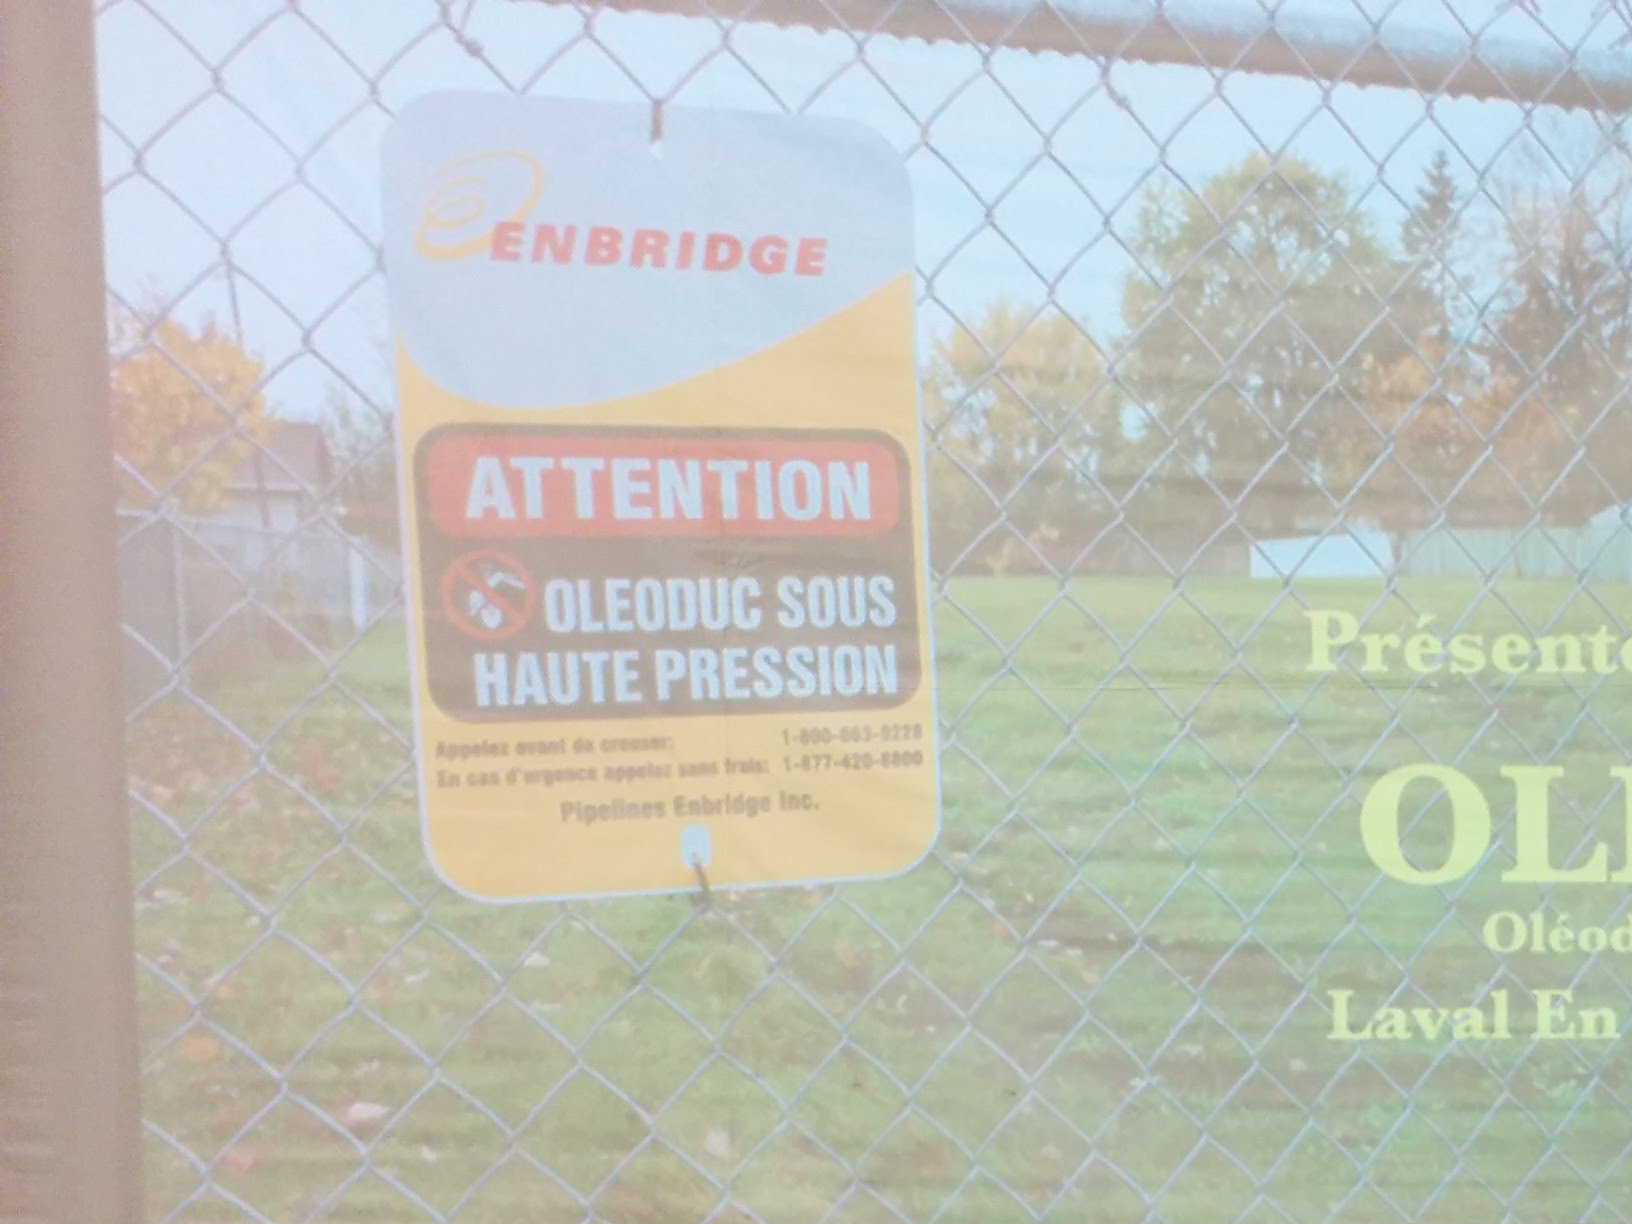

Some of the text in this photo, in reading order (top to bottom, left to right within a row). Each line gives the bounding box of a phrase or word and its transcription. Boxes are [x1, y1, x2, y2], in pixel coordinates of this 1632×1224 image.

[489, 221, 828, 276] ENBRIDGE
[465, 455, 872, 520] ATTENTION
[545, 575, 896, 633] OLEODUC SOUS
[474, 644, 898, 706] HAUTE PRESSION
[561, 789, 820, 825] Pipelines Enbridge Inc.
[1326, 989, 1512, 1041] Laval
[1531, 989, 1621, 1040] En
